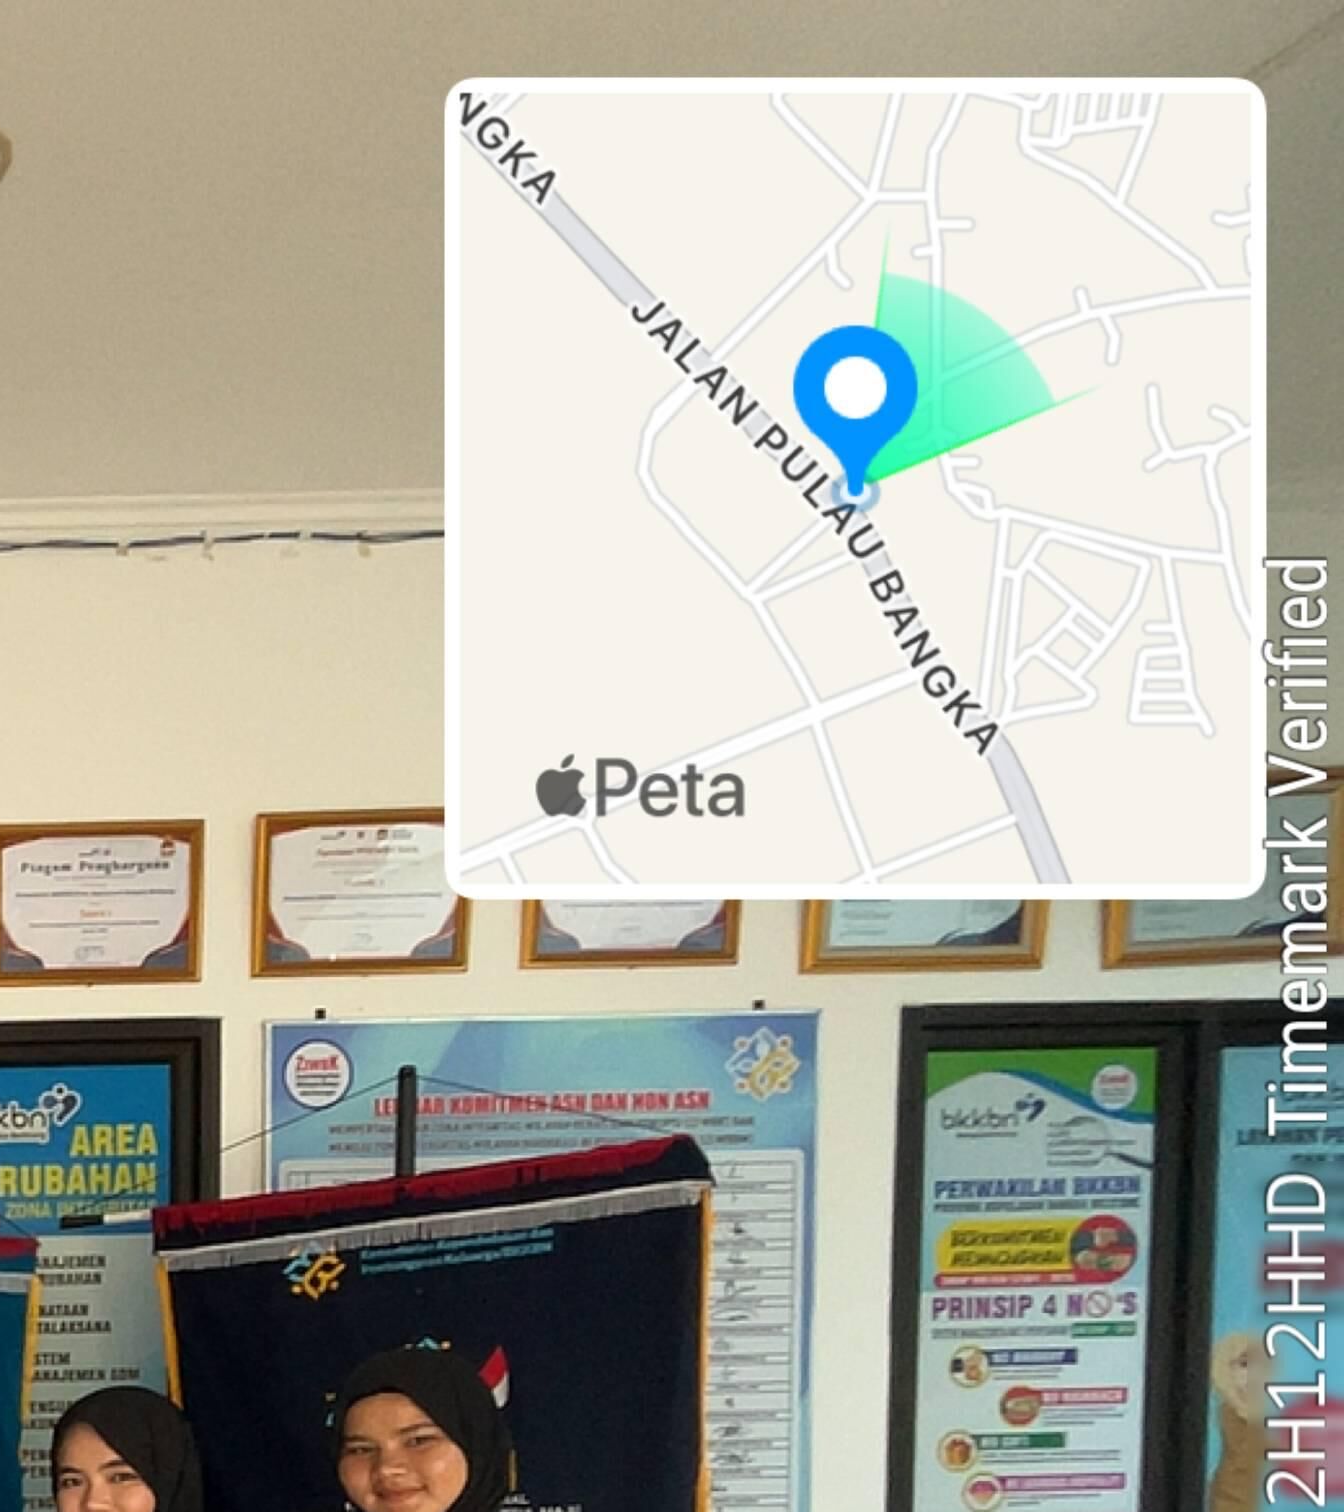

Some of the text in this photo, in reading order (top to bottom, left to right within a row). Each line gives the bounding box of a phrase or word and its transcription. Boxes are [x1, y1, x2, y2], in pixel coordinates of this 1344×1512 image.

[69, 1123, 159, 1157] AREA
[932, 1294, 1033, 1320] PRINSIP
[1041, 1293, 1058, 1318] 4
